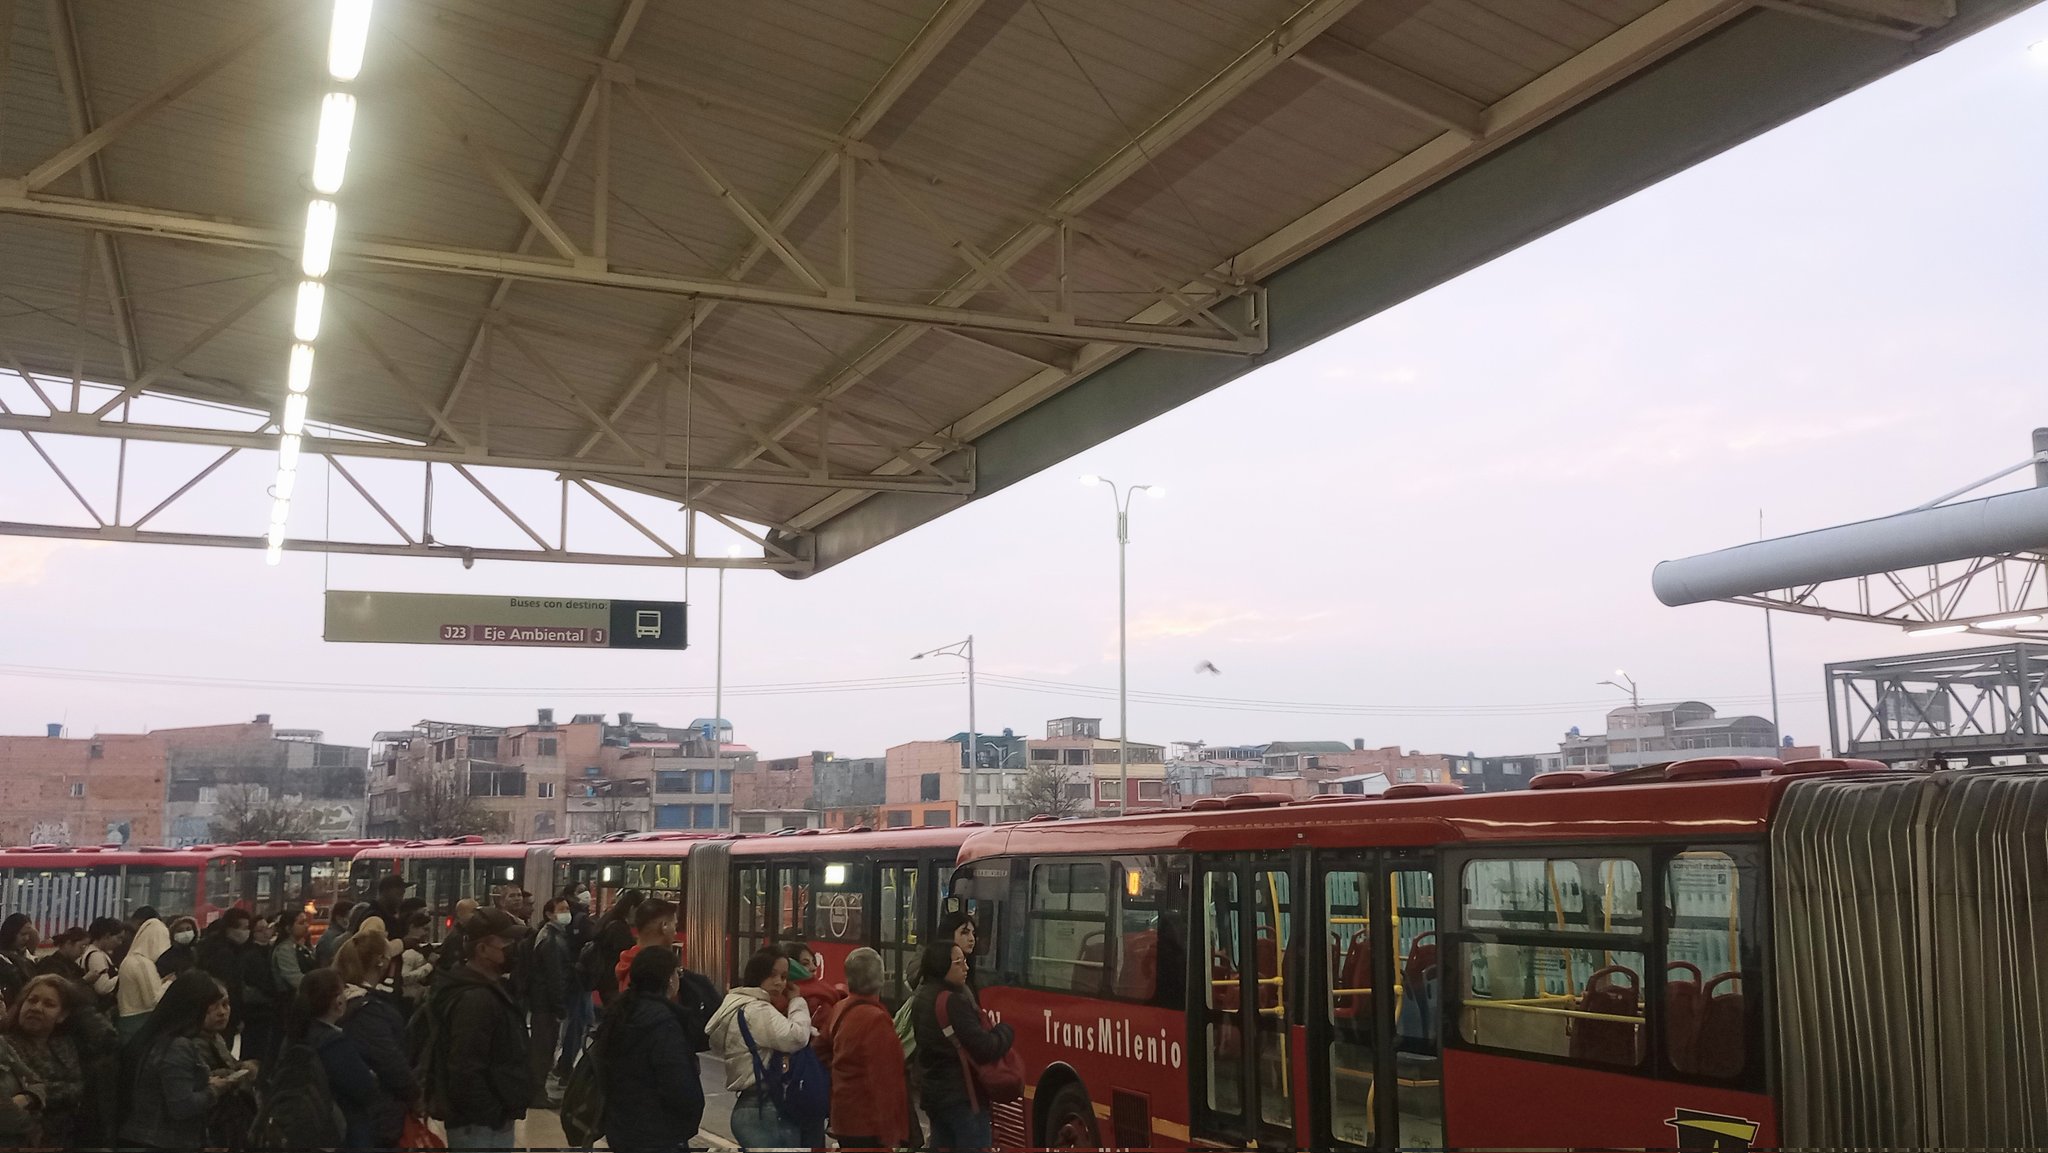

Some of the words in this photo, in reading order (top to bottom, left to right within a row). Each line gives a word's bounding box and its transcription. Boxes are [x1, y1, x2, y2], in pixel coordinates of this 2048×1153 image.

[510, 598, 540, 608] Buses
[543, 600, 562, 609] con
[565, 600, 608, 610] destino:
[444, 626, 467, 639] J23
[484, 627, 506, 641] Eje
[509, 628, 584, 642] Ambiental
[595, 630, 603, 642] J
[1043, 1009, 1182, 1069] TransMilenio
